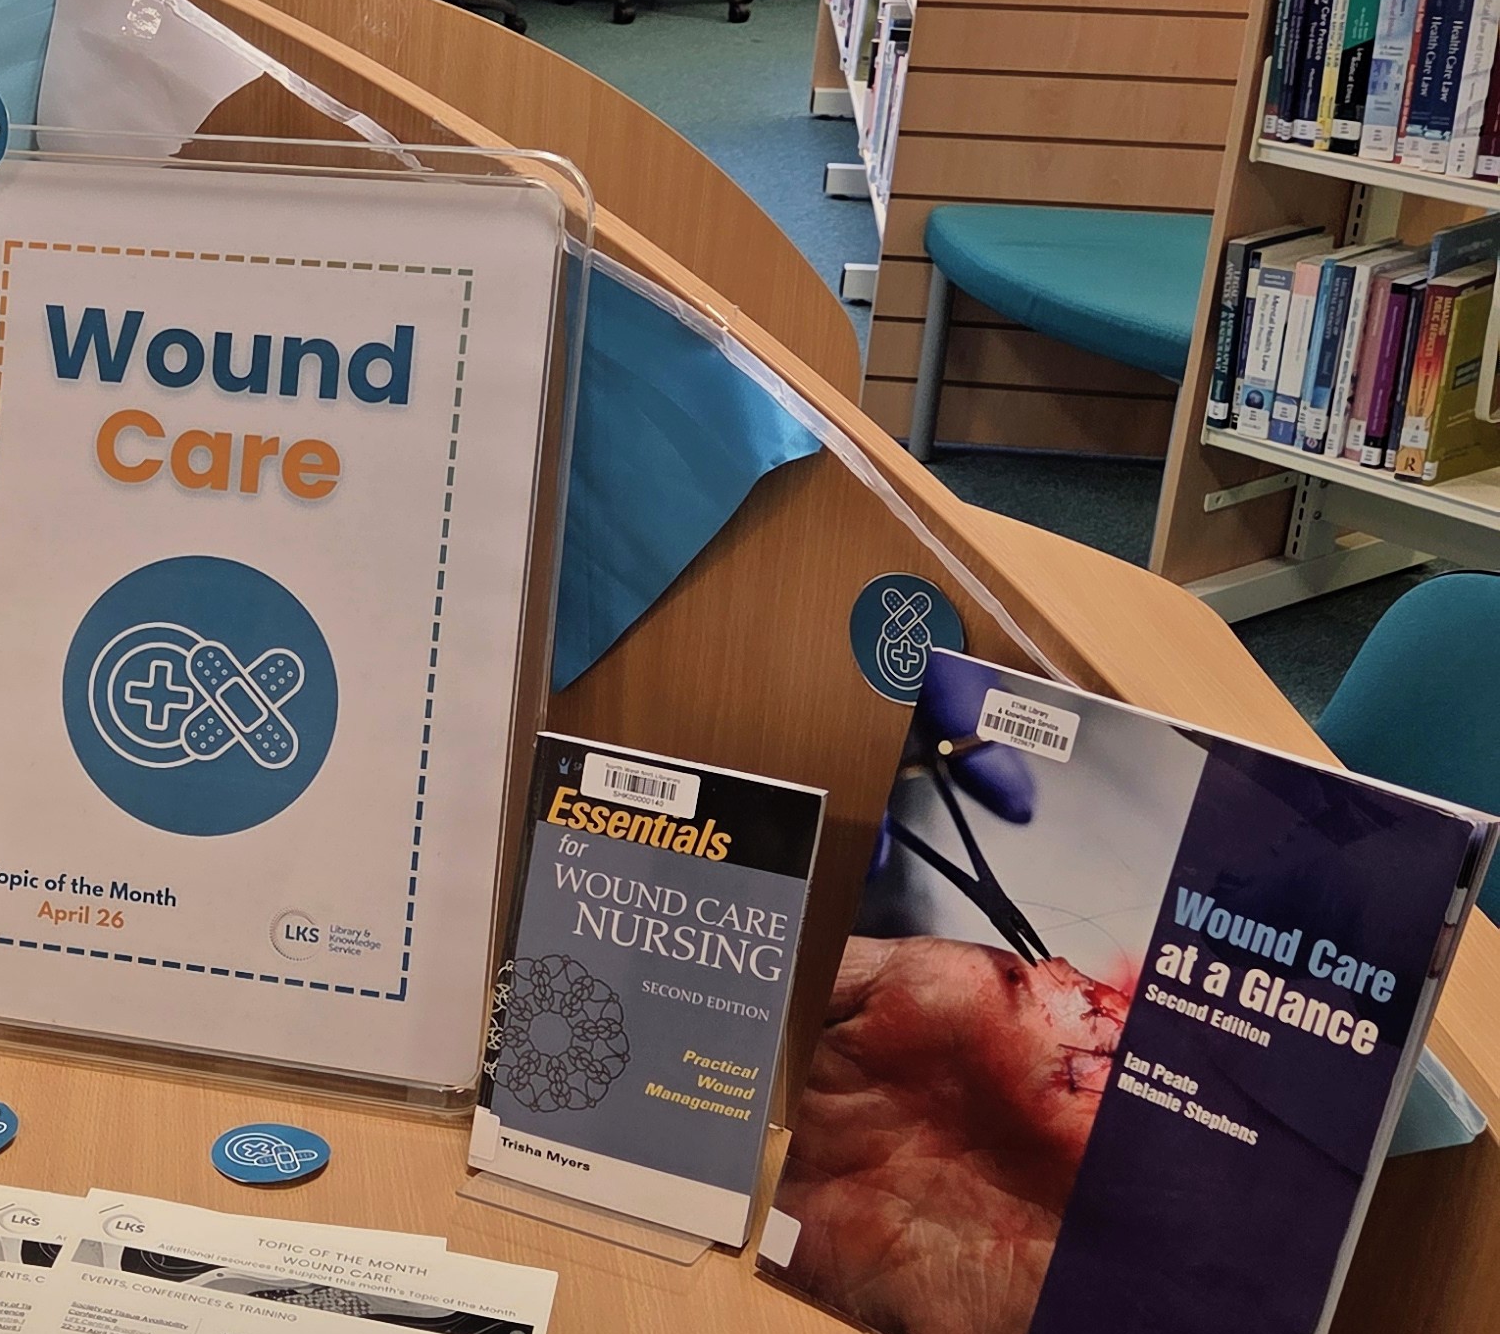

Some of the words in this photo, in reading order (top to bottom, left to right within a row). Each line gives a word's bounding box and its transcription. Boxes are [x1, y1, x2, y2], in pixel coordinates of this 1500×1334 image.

[1318, 7, 1330, 26] Care
[1427, 16, 1443, 50] Health
[1448, 20, 1464, 54] Health
[1423, 51, 1436, 74] Care
[1444, 56, 1458, 79] Care
[1419, 76, 1433, 98] Law
[1440, 81, 1454, 103] Law
[1267, 295, 1281, 325] Mental
[45, 304, 415, 406] Wound
[1263, 326, 1276, 353] Health
[1260, 354, 1272, 372] Law
[96, 409, 342, 500] Care
[546, 785, 733, 863] Essentials
[558, 833, 590, 858] for
[43, 872, 63, 893] of
[67, 874, 105, 899] the
[109, 879, 178, 908] Month
[554, 862, 689, 917] WOUND
[695, 897, 789, 942] CARE
[37, 899, 92, 929] April
[97, 908, 126, 931] 26
[330, 924, 362, 938] Library
[363, 929, 371, 937] &
[285, 925, 319, 943] LKS
[328, 943, 362, 955] Service
[329, 934, 381, 949] Knowledge
[572, 901, 785, 983] NURSING
[1173, 884, 1304, 971] Wound
[1307, 937, 1398, 1005] Care
[641, 979, 704, 1006] SECOND
[706, 995, 771, 1022] EDITION
[1154, 939, 1199, 986] at
[1207, 962, 1230, 997] a
[1237, 964, 1381, 1058] Glance
[1145, 983, 1205, 1026] Second
[1209, 1007, 1272, 1050] Edition
[682, 1049, 760, 1081] Practical
[1123, 1050, 1148, 1075] Ian
[1150, 1060, 1199, 1098] Peate
[644, 1081, 752, 1122] Management
[697, 1073, 756, 1101] Wound
[1117, 1073, 1182, 1117] Melanie
[1182, 1094, 1259, 1147] Stephens
[500, 1136, 544, 1159] Trisha
[545, 1147, 592, 1173] Myers
[11, 1215, 41, 1227] LKS
[115, 1219, 146, 1235] LKS
[257, 1237, 302, 1254] TOPIC
[308, 1245, 328, 1259] OF
[334, 1250, 364, 1266] THE
[368, 1255, 428, 1278] MONTH
[282, 1255, 337, 1275] WOUND
[341, 1266, 394, 1285] CARE
[81, 1271, 128, 1291] EVENTS,
[132, 1279, 221, 1309] CONFERENCES
[224, 1299, 236, 1311] &
[238, 1301, 300, 1323] TRAINING
